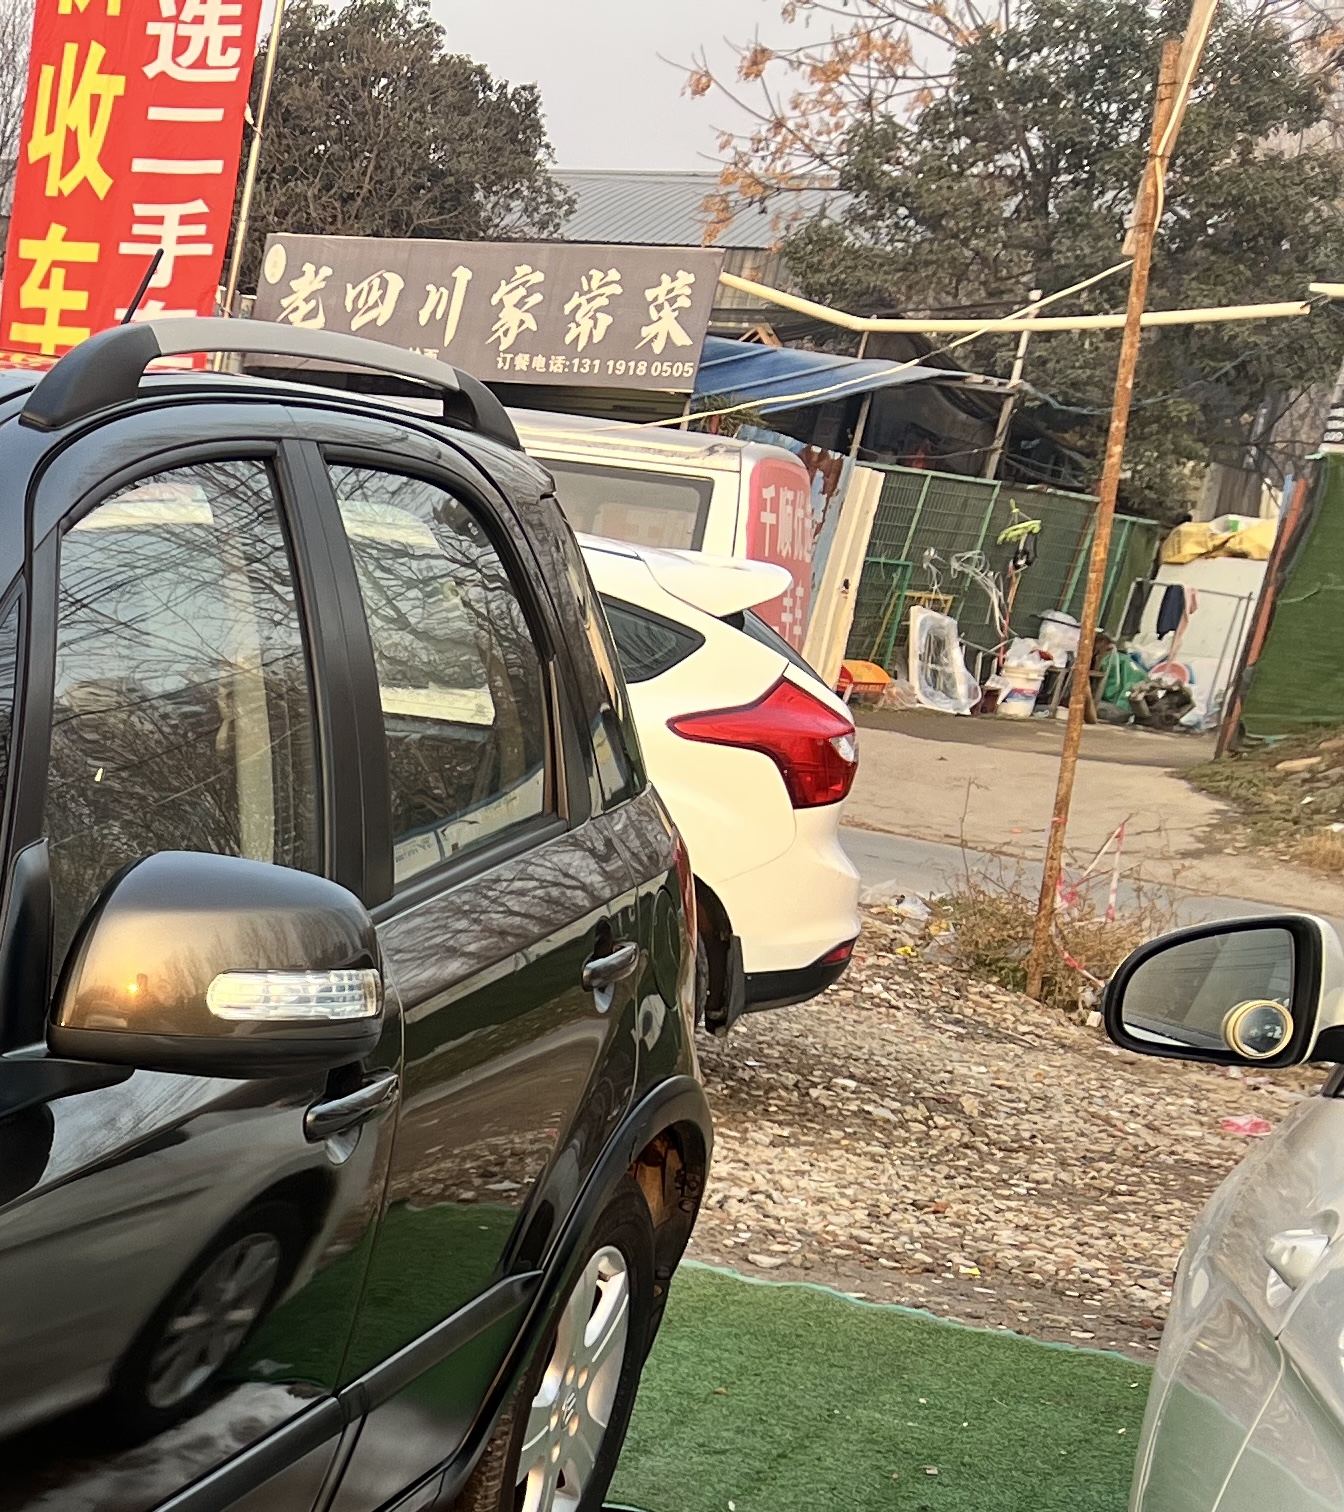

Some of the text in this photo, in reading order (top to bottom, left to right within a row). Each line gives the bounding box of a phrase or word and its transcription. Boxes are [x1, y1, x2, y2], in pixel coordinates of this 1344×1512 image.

[277, 262, 699, 356] 老四川家常菜
[606, 359, 649, 376] 1918
[650, 361, 694, 378] 0505
